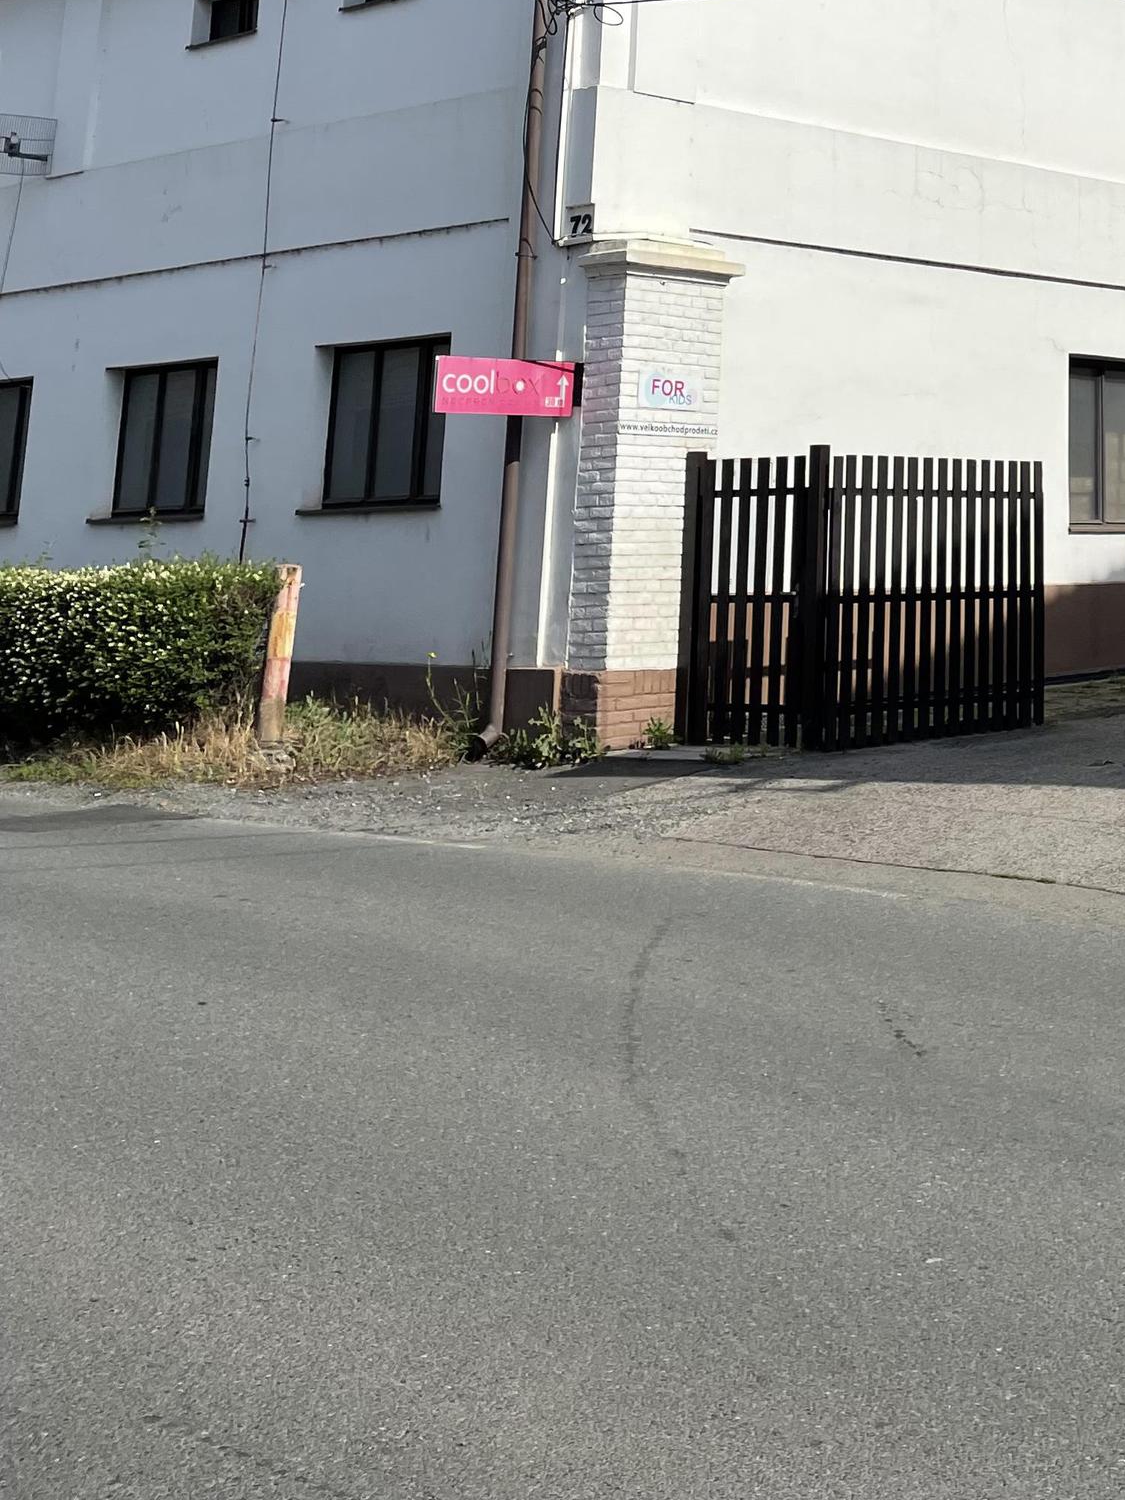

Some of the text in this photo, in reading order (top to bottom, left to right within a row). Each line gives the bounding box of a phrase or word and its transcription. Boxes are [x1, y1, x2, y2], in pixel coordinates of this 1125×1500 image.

[570, 214, 592, 237] 72
[651, 379, 685, 397] FOR
[669, 394, 692, 405] KIDS
